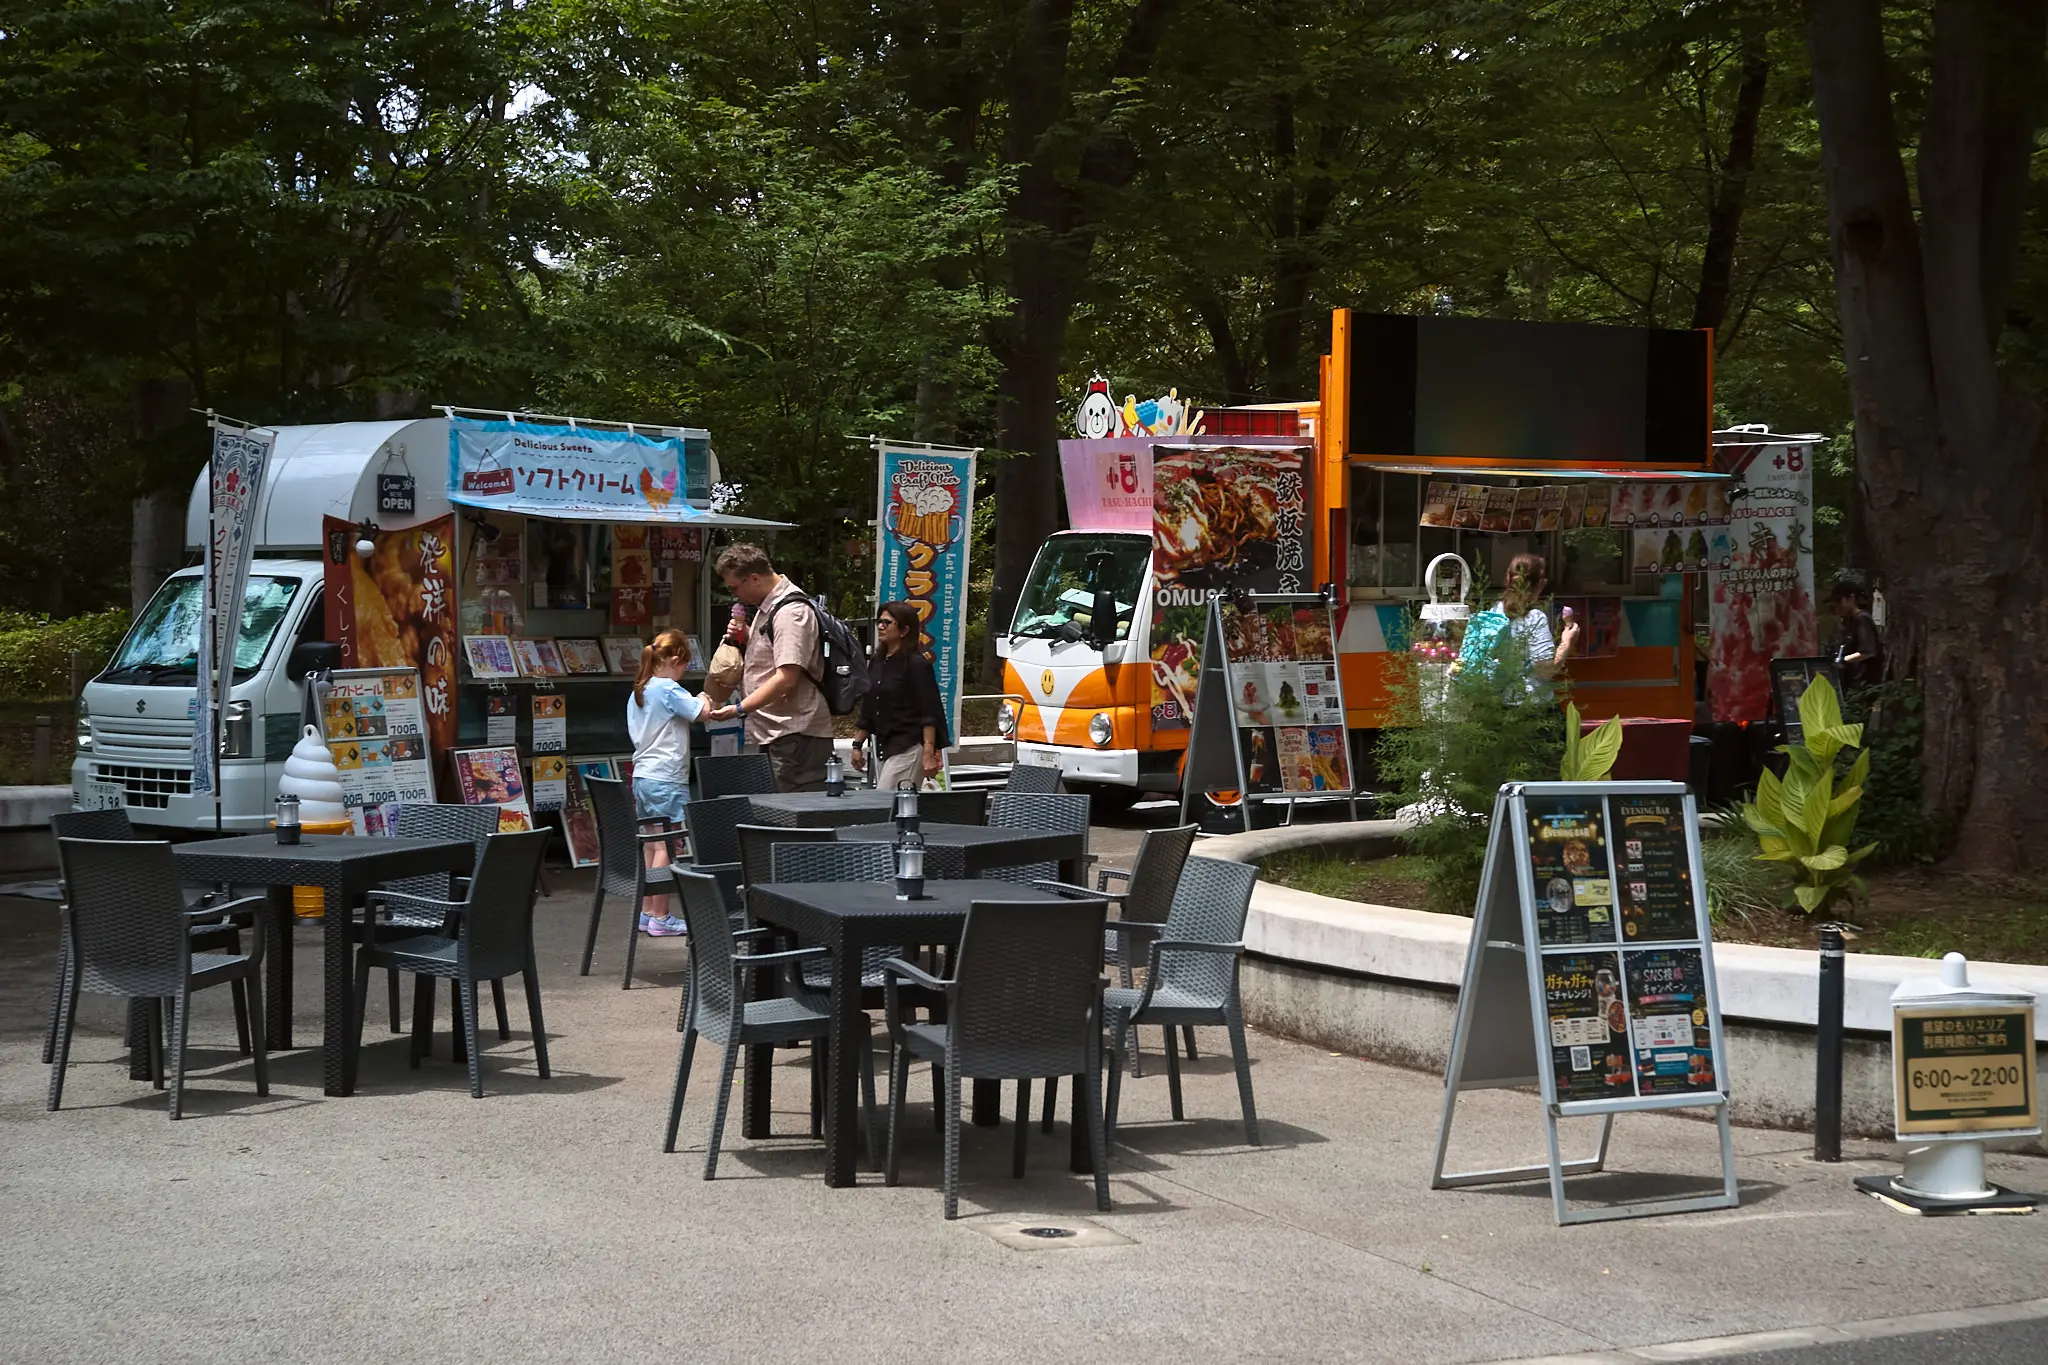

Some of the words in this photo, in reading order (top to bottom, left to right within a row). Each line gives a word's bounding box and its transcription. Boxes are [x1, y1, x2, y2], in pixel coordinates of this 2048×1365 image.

[514, 438, 558, 451] Delicious
[560, 443, 593, 454] Sweets
[898, 460, 954, 475] Delicious
[467, 480, 511, 491] Welcome!
[517, 465, 635, 496] ソフトクリーム
[891, 473, 929, 490] Craft
[930, 475, 961, 486] Beer
[382, 497, 413, 510] OPEN
[889, 549, 902, 588] coming
[944, 553, 957, 580] Let's
[618, 588, 648, 599] コロッケ
[943, 583, 955, 614] drink
[418, 530, 450, 722] 発祥の味
[942, 617, 953, 642] beer
[939, 646, 953, 689] happily
[325, 684, 383, 698] ラフトビール
[391, 724, 418, 735] 700円
[536, 741, 562, 751] 700円
[343, 793, 364, 804] 00円
[370, 791, 397, 802] 700円
[400, 788, 427, 799] 700円
[1621, 806, 1655, 816] EVENING
[1655, 806, 1671, 815] BAR
[1543, 827, 1573, 838] EVENING
[1575, 826, 1590, 837] BAR
[1545, 973, 1594, 990] ガチャガチャ
[1643, 982, 1688, 994] キャンペーン
